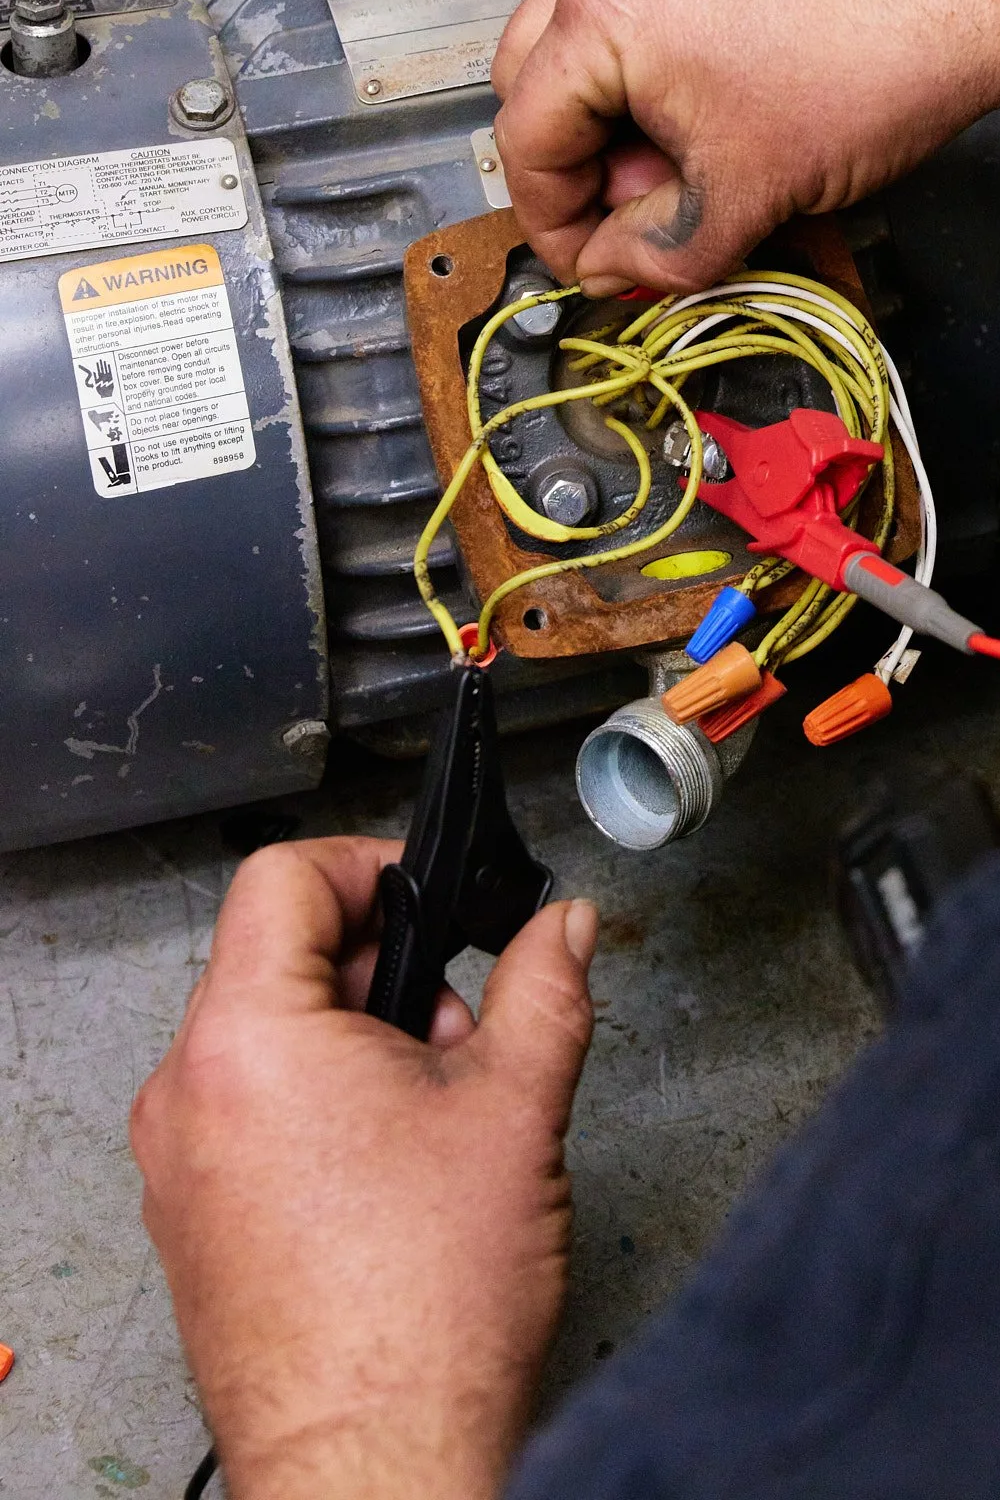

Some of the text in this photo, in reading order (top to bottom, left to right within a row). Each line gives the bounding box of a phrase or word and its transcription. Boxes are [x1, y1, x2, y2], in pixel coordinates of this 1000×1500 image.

[94, 163, 119, 171] MOTOR
[121, 157, 170, 168] THERMOSTATS
[131, 149, 170, 159] CAUTION
[0, 157, 99, 176] ONNECTION DIAGRAM
[95, 167, 137, 177] CONNECTED
[139, 163, 166, 172] BEFORE
[168, 159, 206, 168] OPERATION
[216, 155, 233, 163] UNIT
[171, 163, 221, 173] THERMOSTATS
[164, 187, 189, 195] SWITCH
[167, 178, 210, 188] MOMENTARY
[49, 209, 100, 220] THERMOSTATS
[182, 211, 240, 223] POWER CIRCUIT
[200, 205, 233, 215] CONTROL
[2, 217, 34, 226] HEATERS
[6, 230, 43, 240] CONTACTS
[102, 226, 166, 238] HOLDING CONTACT
[1, 244, 33, 253] STARTER
[102, 258, 208, 291] WARNING
[71, 292, 218, 325] Improper installation of this motor may
[73, 321, 95, 334] result
[97, 320, 104, 329] in
[159, 306, 186, 318] electric
[188, 301, 210, 312] shock
[212, 300, 220, 308] or
[75, 332, 95, 344] other
[98, 328, 131, 342] personal
[186, 311, 222, 325] operating
[77, 340, 122, 354] instructions.
[118, 337, 209, 361] Disconnect power before
[120, 344, 231, 370] maintenance. Open all circuits
[122, 358, 210, 381] before removing conduit
[140, 377, 161, 387] cover.
[164, 375, 174, 383] Be
[177, 371, 192, 379] sure
[195, 368, 220, 377] motor
[218, 365, 225, 373] is
[125, 375, 226, 403] properly grounded per local
[128, 391, 199, 411] and national codes.
[130, 417, 142, 426] Do
[144, 416, 157, 424] not
[159, 410, 181, 423] place
[182, 405, 209, 418] fingers
[132, 413, 219, 436] objects near openings.
[133, 425, 245, 454] Do not use eyebolts or lifting
[135, 454, 159, 464] hooks
[171, 448, 181, 457] lift
[183, 441, 216, 455] anything
[218, 435, 244, 447] except
[137, 452, 245, 472] the product. 898958
